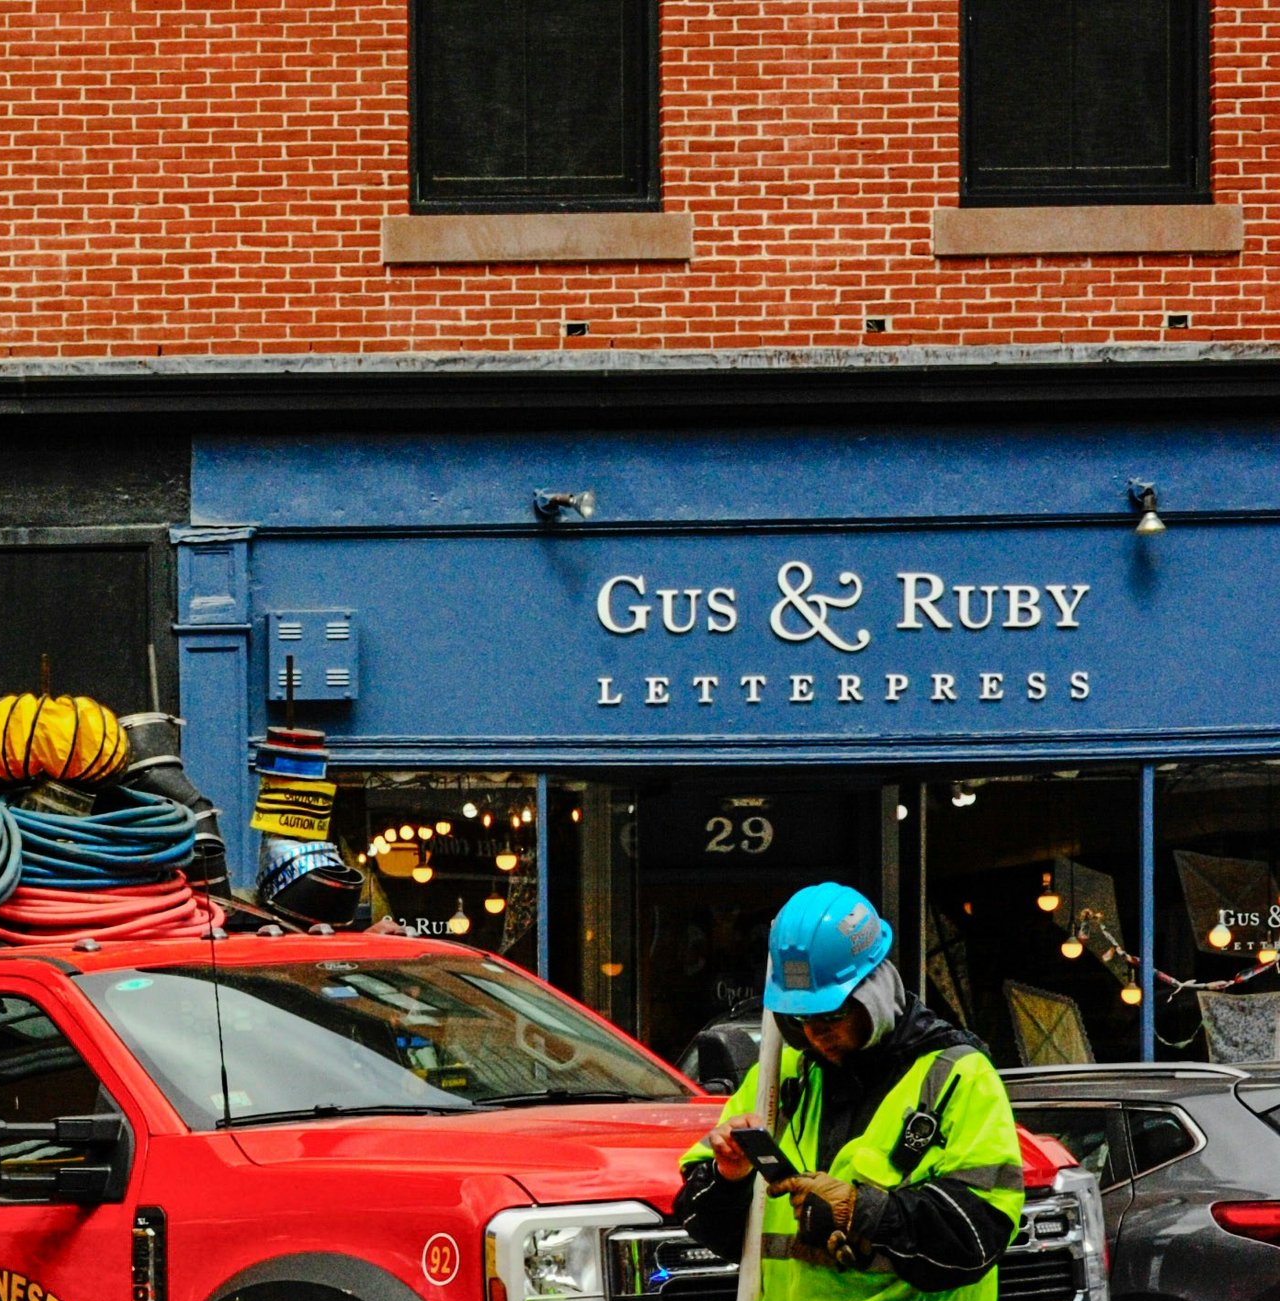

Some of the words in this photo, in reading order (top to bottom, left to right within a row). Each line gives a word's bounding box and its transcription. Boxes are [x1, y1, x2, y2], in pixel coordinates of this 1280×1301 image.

[770, 560, 870, 652] &
[598, 672, 1090, 705] LETTERPRESS
[279, 814, 315, 830] CAUTION
[705, 816, 774, 854] 29
[429, 1246, 452, 1275] 92
